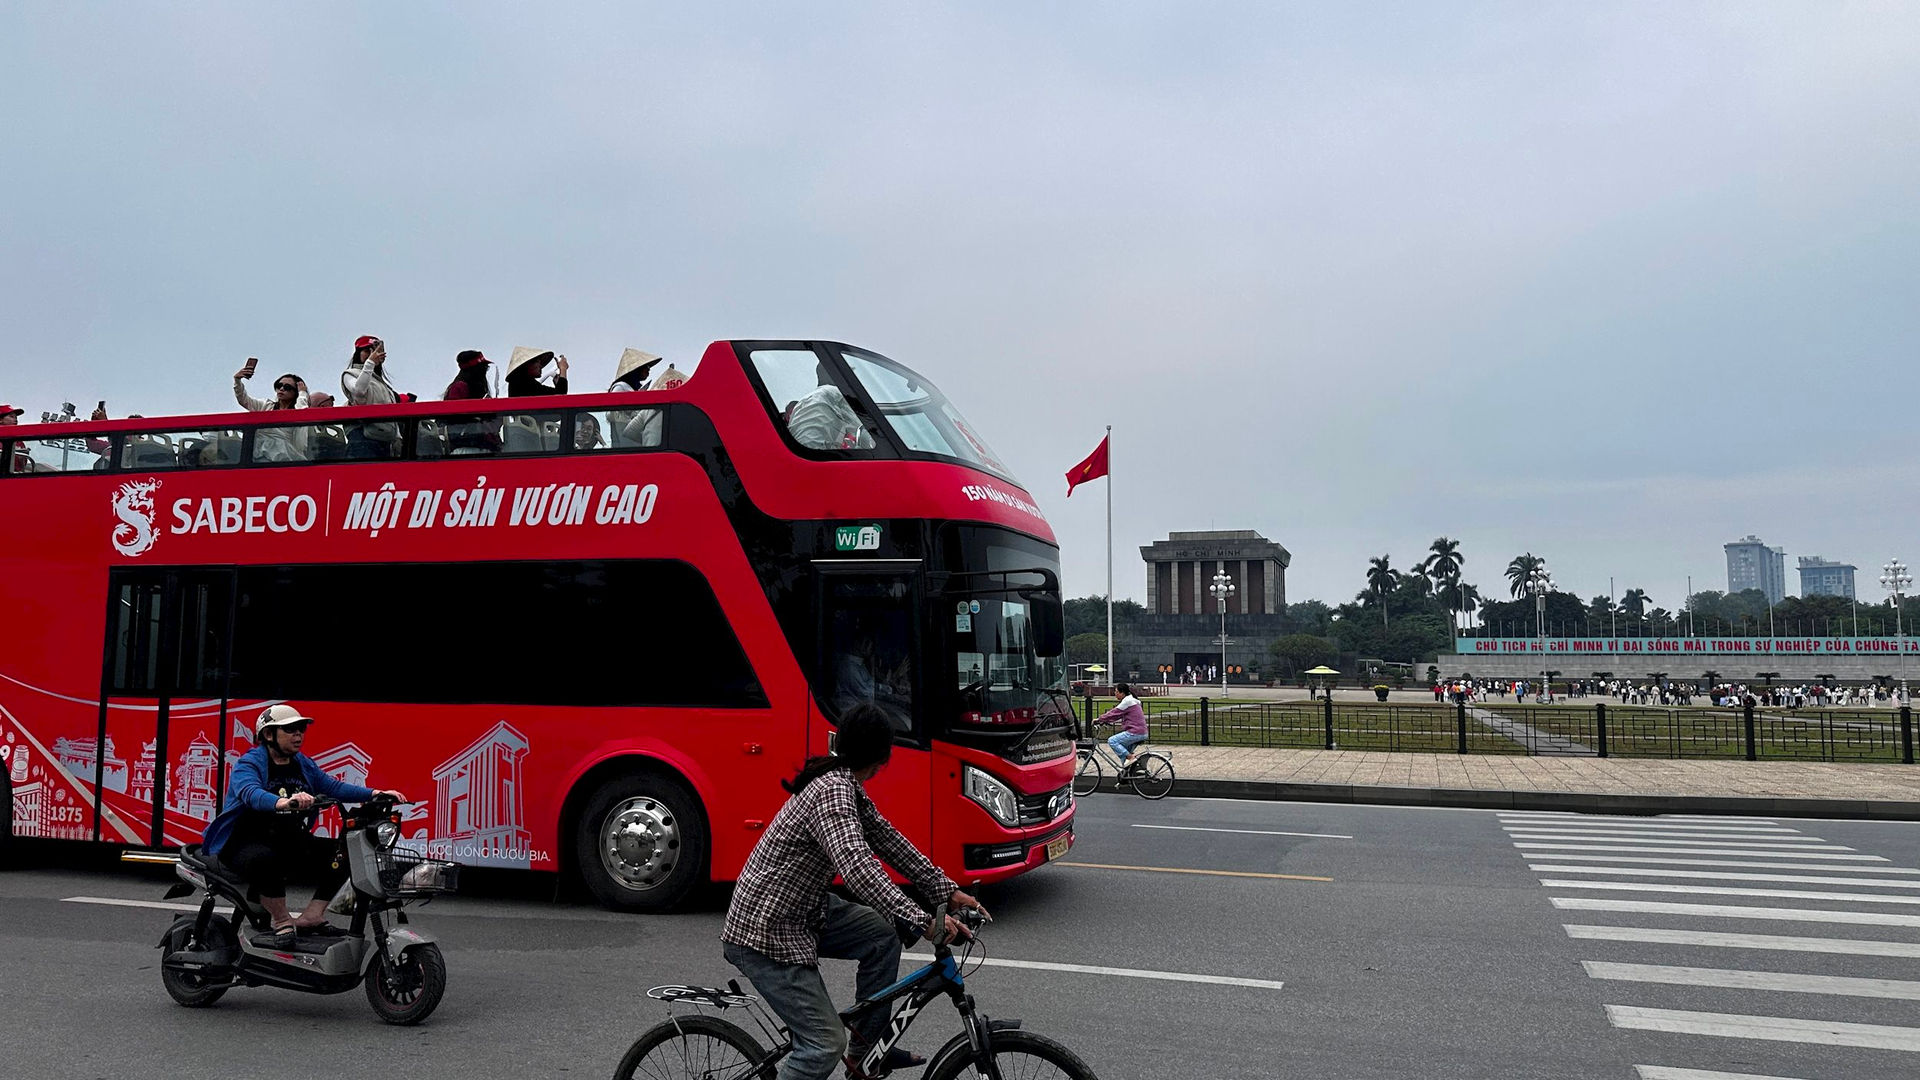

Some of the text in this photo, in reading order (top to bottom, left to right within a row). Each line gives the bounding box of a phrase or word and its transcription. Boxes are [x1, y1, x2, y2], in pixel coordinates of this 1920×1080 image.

[961, 485, 987, 501] 150
[170, 494, 317, 535] SABECO
[343, 476, 658, 538] MỘT DI SẢN VƯƠN CAO
[1476, 638, 1498, 651] CHỦ
[1502, 641, 1526, 653] TỊCH
[1573, 641, 1603, 651] MINH
[1623, 641, 1643, 653] ĐẠI
[1647, 637, 1679, 651] SỐNG
[1711, 641, 1750, 651] TRONG
[1755, 639, 1772, 653] SỰ
[1775, 638, 1820, 654] NGHIỆP
[1825, 637, 1850, 651] CỦA
[1855, 638, 1898, 651] CHÚNG
[1903, 641, 1919, 651] TA
[51, 806, 83, 823] 1875
[455, 843, 490, 859] UỐNG
[492, 848, 526, 862] RƯỢU
